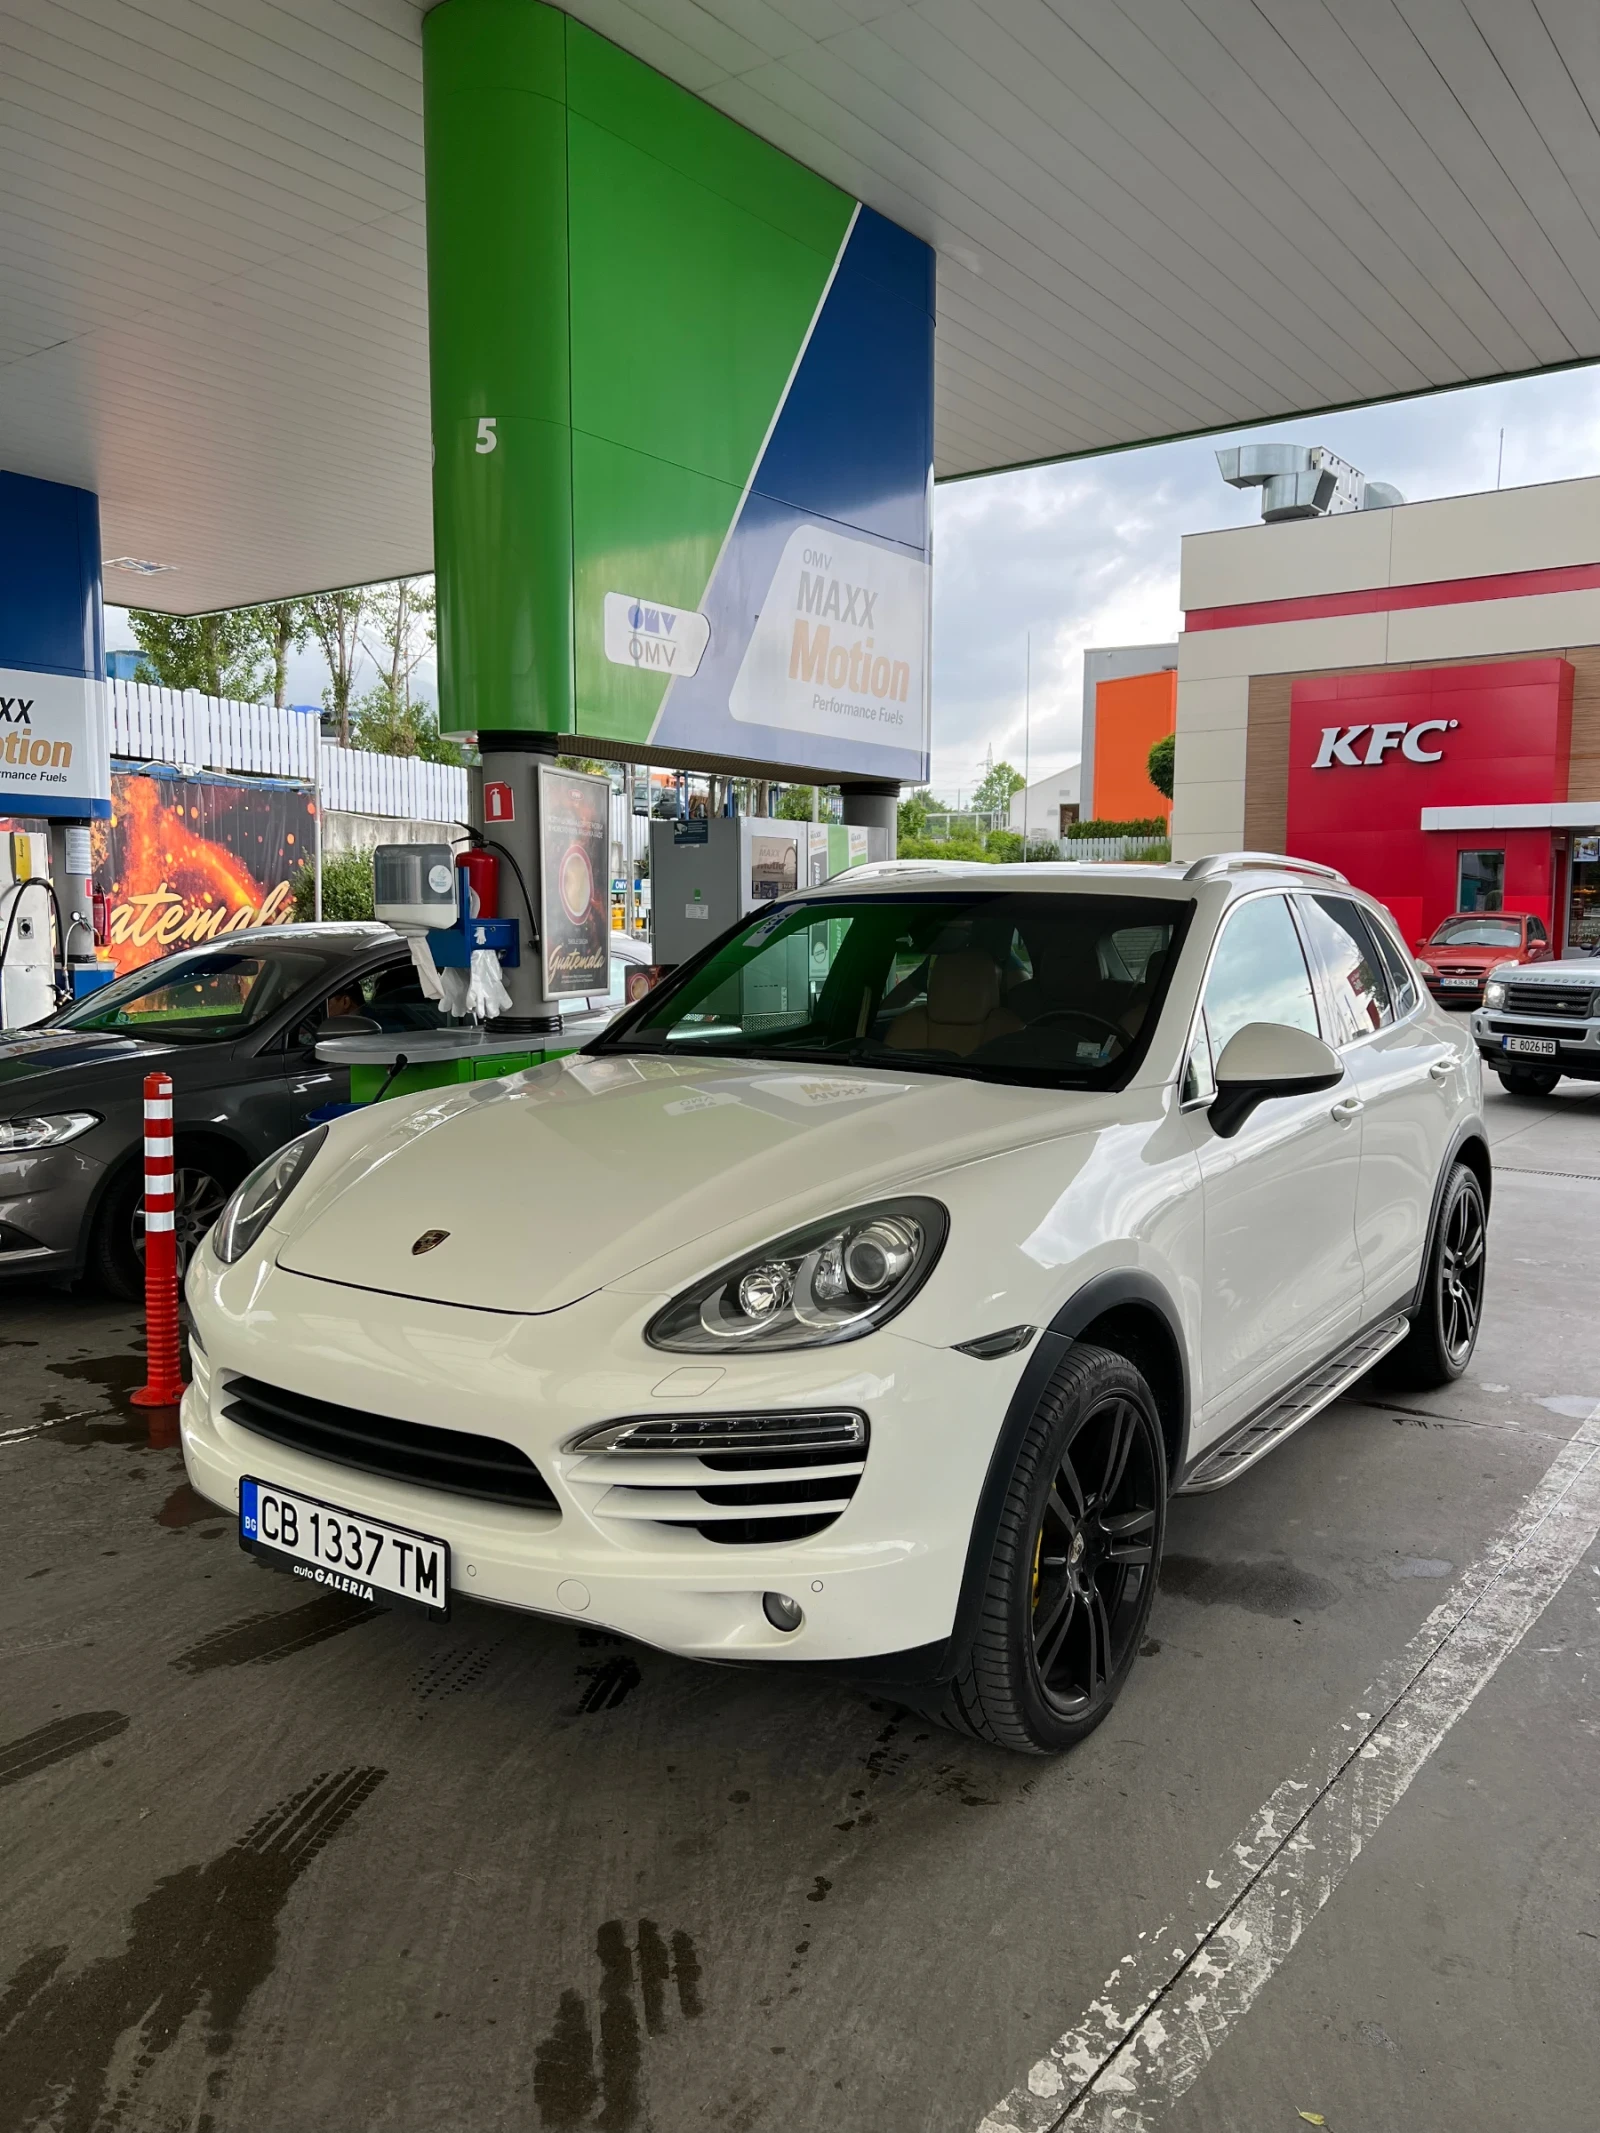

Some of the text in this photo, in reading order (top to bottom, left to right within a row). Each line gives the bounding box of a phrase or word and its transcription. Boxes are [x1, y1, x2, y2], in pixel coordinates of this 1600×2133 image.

[475, 417, 497, 454] 5
[803, 548, 833, 571] OMV
[797, 570, 878, 630] MAXX
[629, 637, 676, 667] OMV
[788, 618, 910, 703] Motion
[812, 694, 904, 725] Performance Fuels
[0, 728, 73, 768] tion
[1311, 719, 1450, 768] KFC
[40, 772, 67, 783] Fuels
[549, 943, 606, 985] Guatemala
[1510, 1039, 1516, 1050] E
[244, 1516, 257, 1532] BG
[262, 1495, 438, 1599] CB 1337 TM
[293, 1563, 374, 1602] auto GALERIA
